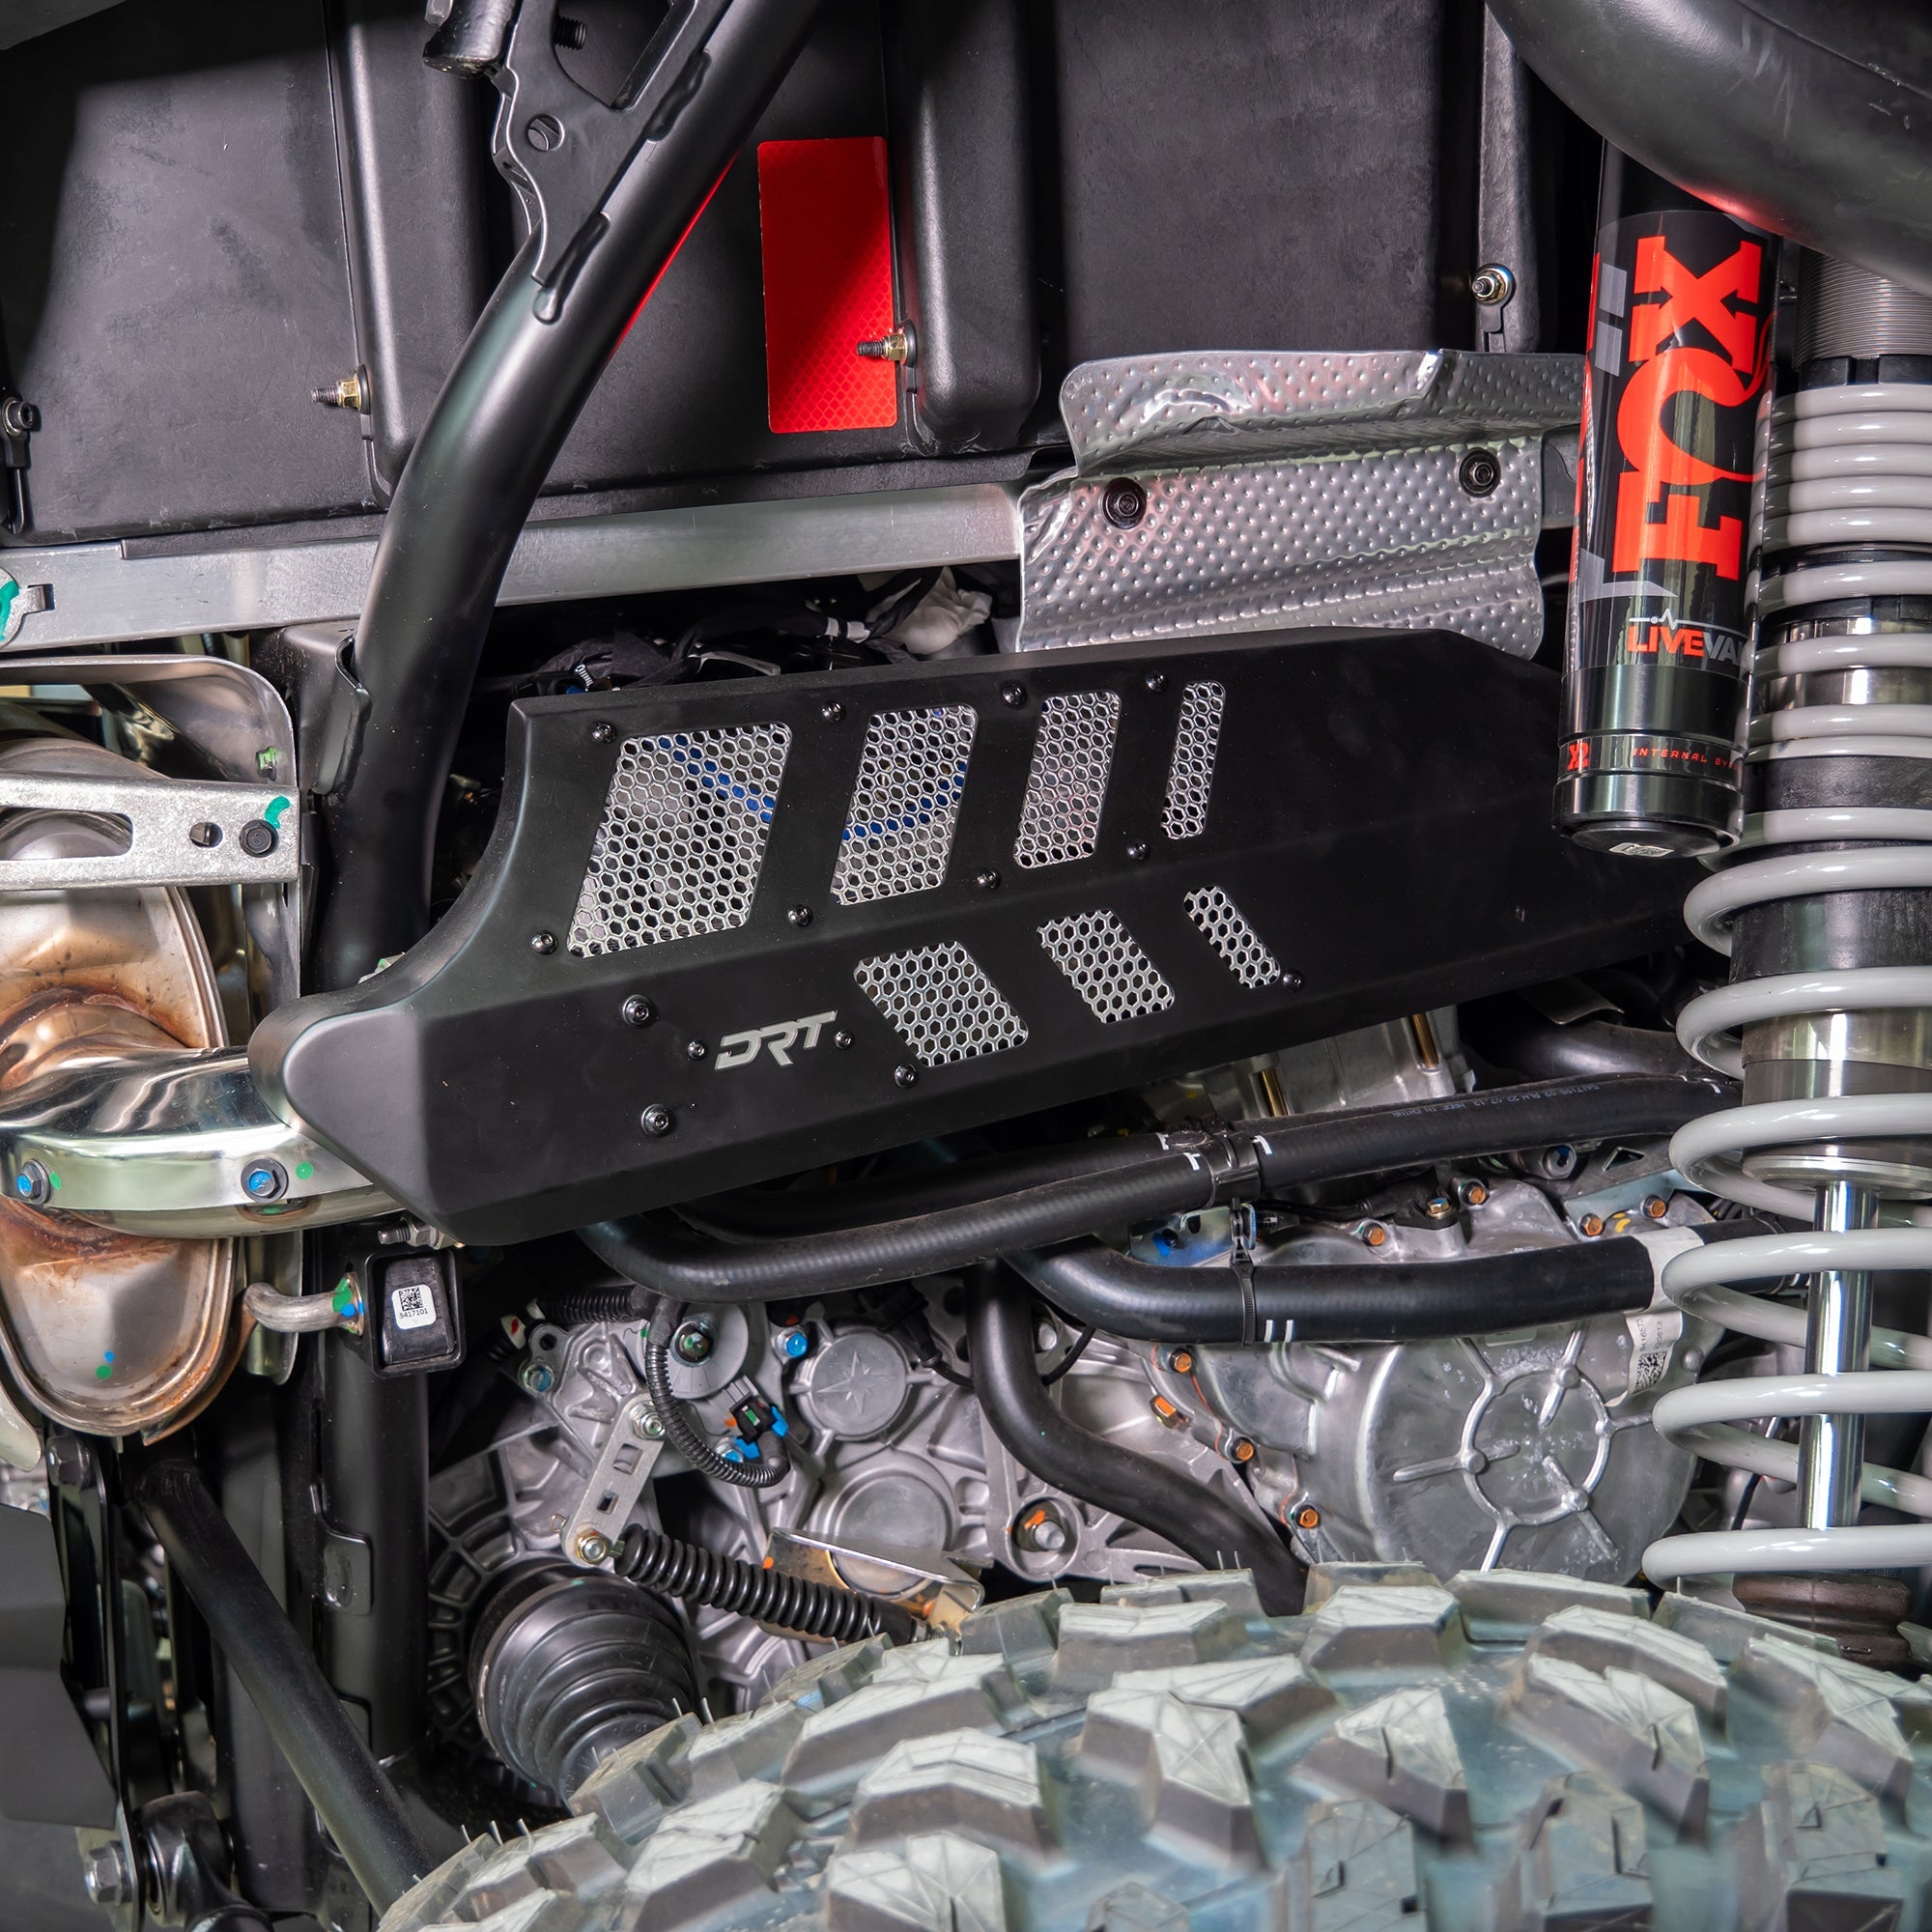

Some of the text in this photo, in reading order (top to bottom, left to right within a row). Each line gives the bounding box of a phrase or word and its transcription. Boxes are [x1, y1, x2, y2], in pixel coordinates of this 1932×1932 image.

[1612, 235, 1776, 582] FOX
[1627, 625, 1744, 666] LIVEVA
[1632, 747, 1708, 763] INTERNAL
[714, 1009, 838, 1070] DRT
[399, 1308, 428, 1319] 5417101
